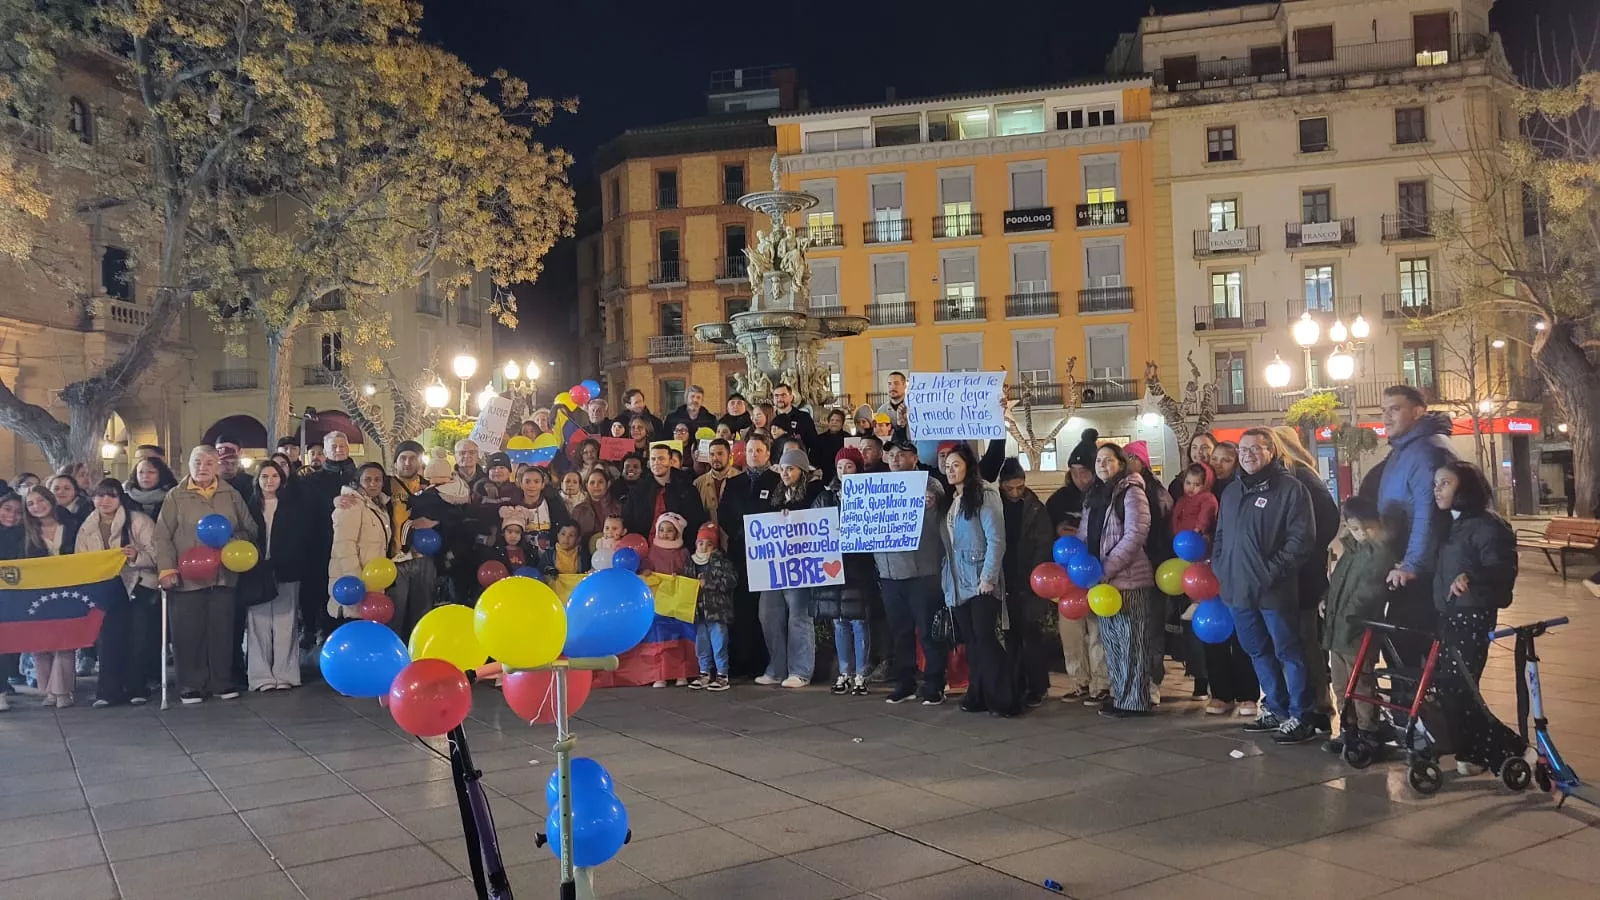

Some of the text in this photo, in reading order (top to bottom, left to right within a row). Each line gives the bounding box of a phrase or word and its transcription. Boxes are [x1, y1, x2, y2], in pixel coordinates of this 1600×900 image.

[1005, 214, 1051, 225] PODÓLOGO
[911, 376, 925, 390] La
[960, 387, 992, 409] dejar
[909, 407, 918, 423] el
[923, 407, 955, 421] miedo
[957, 423, 966, 435] el
[750, 518, 830, 541] Queremos
[776, 535, 839, 558] Venezuela
[768, 557, 827, 589] LIBRE
